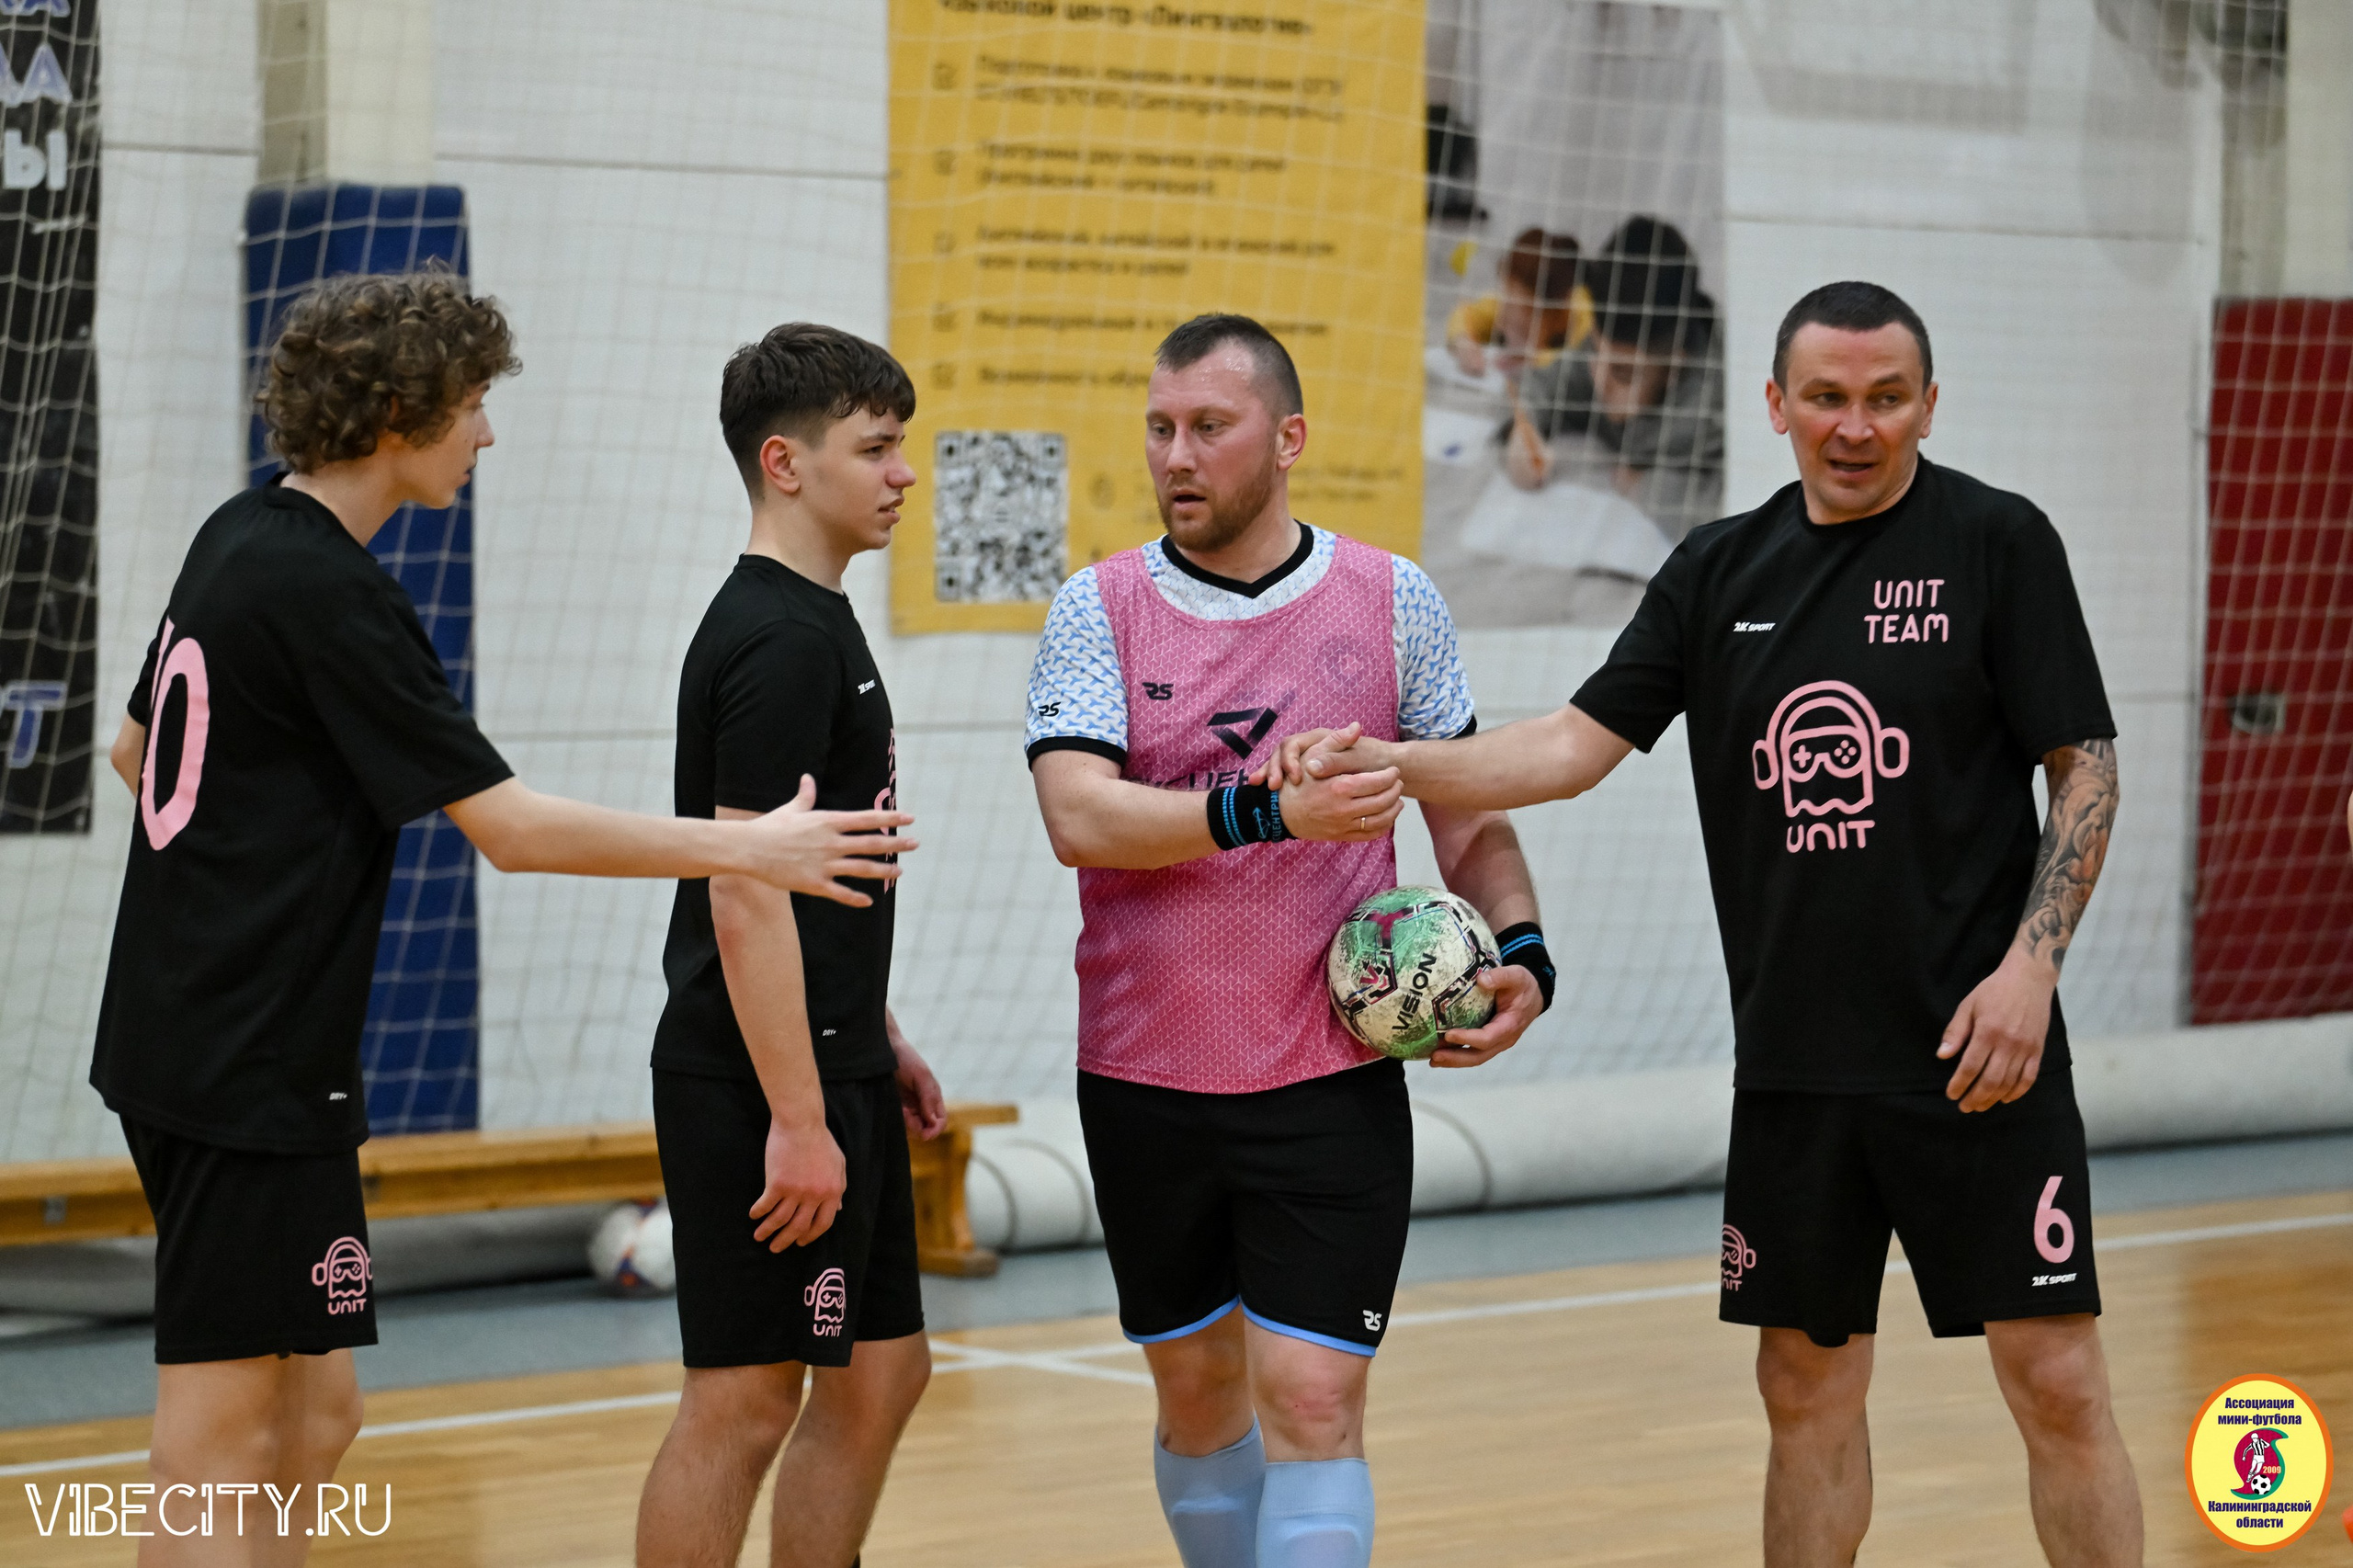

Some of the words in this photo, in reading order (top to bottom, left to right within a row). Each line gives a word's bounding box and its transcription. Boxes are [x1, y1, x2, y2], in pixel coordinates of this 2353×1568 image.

[1874, 579, 1945, 609] UNIT
[1864, 613, 1949, 644] TEAM
[1786, 820, 1875, 853] UNIT
[1392, 952, 1438, 1030] VISION
[2034, 1176, 2075, 1264] 6
[1722, 1277, 1743, 1292] NIT
[2049, 1272, 2077, 1285] SPORT
[327, 1298, 367, 1315] UNIT
[813, 1324, 843, 1337] UNIT
